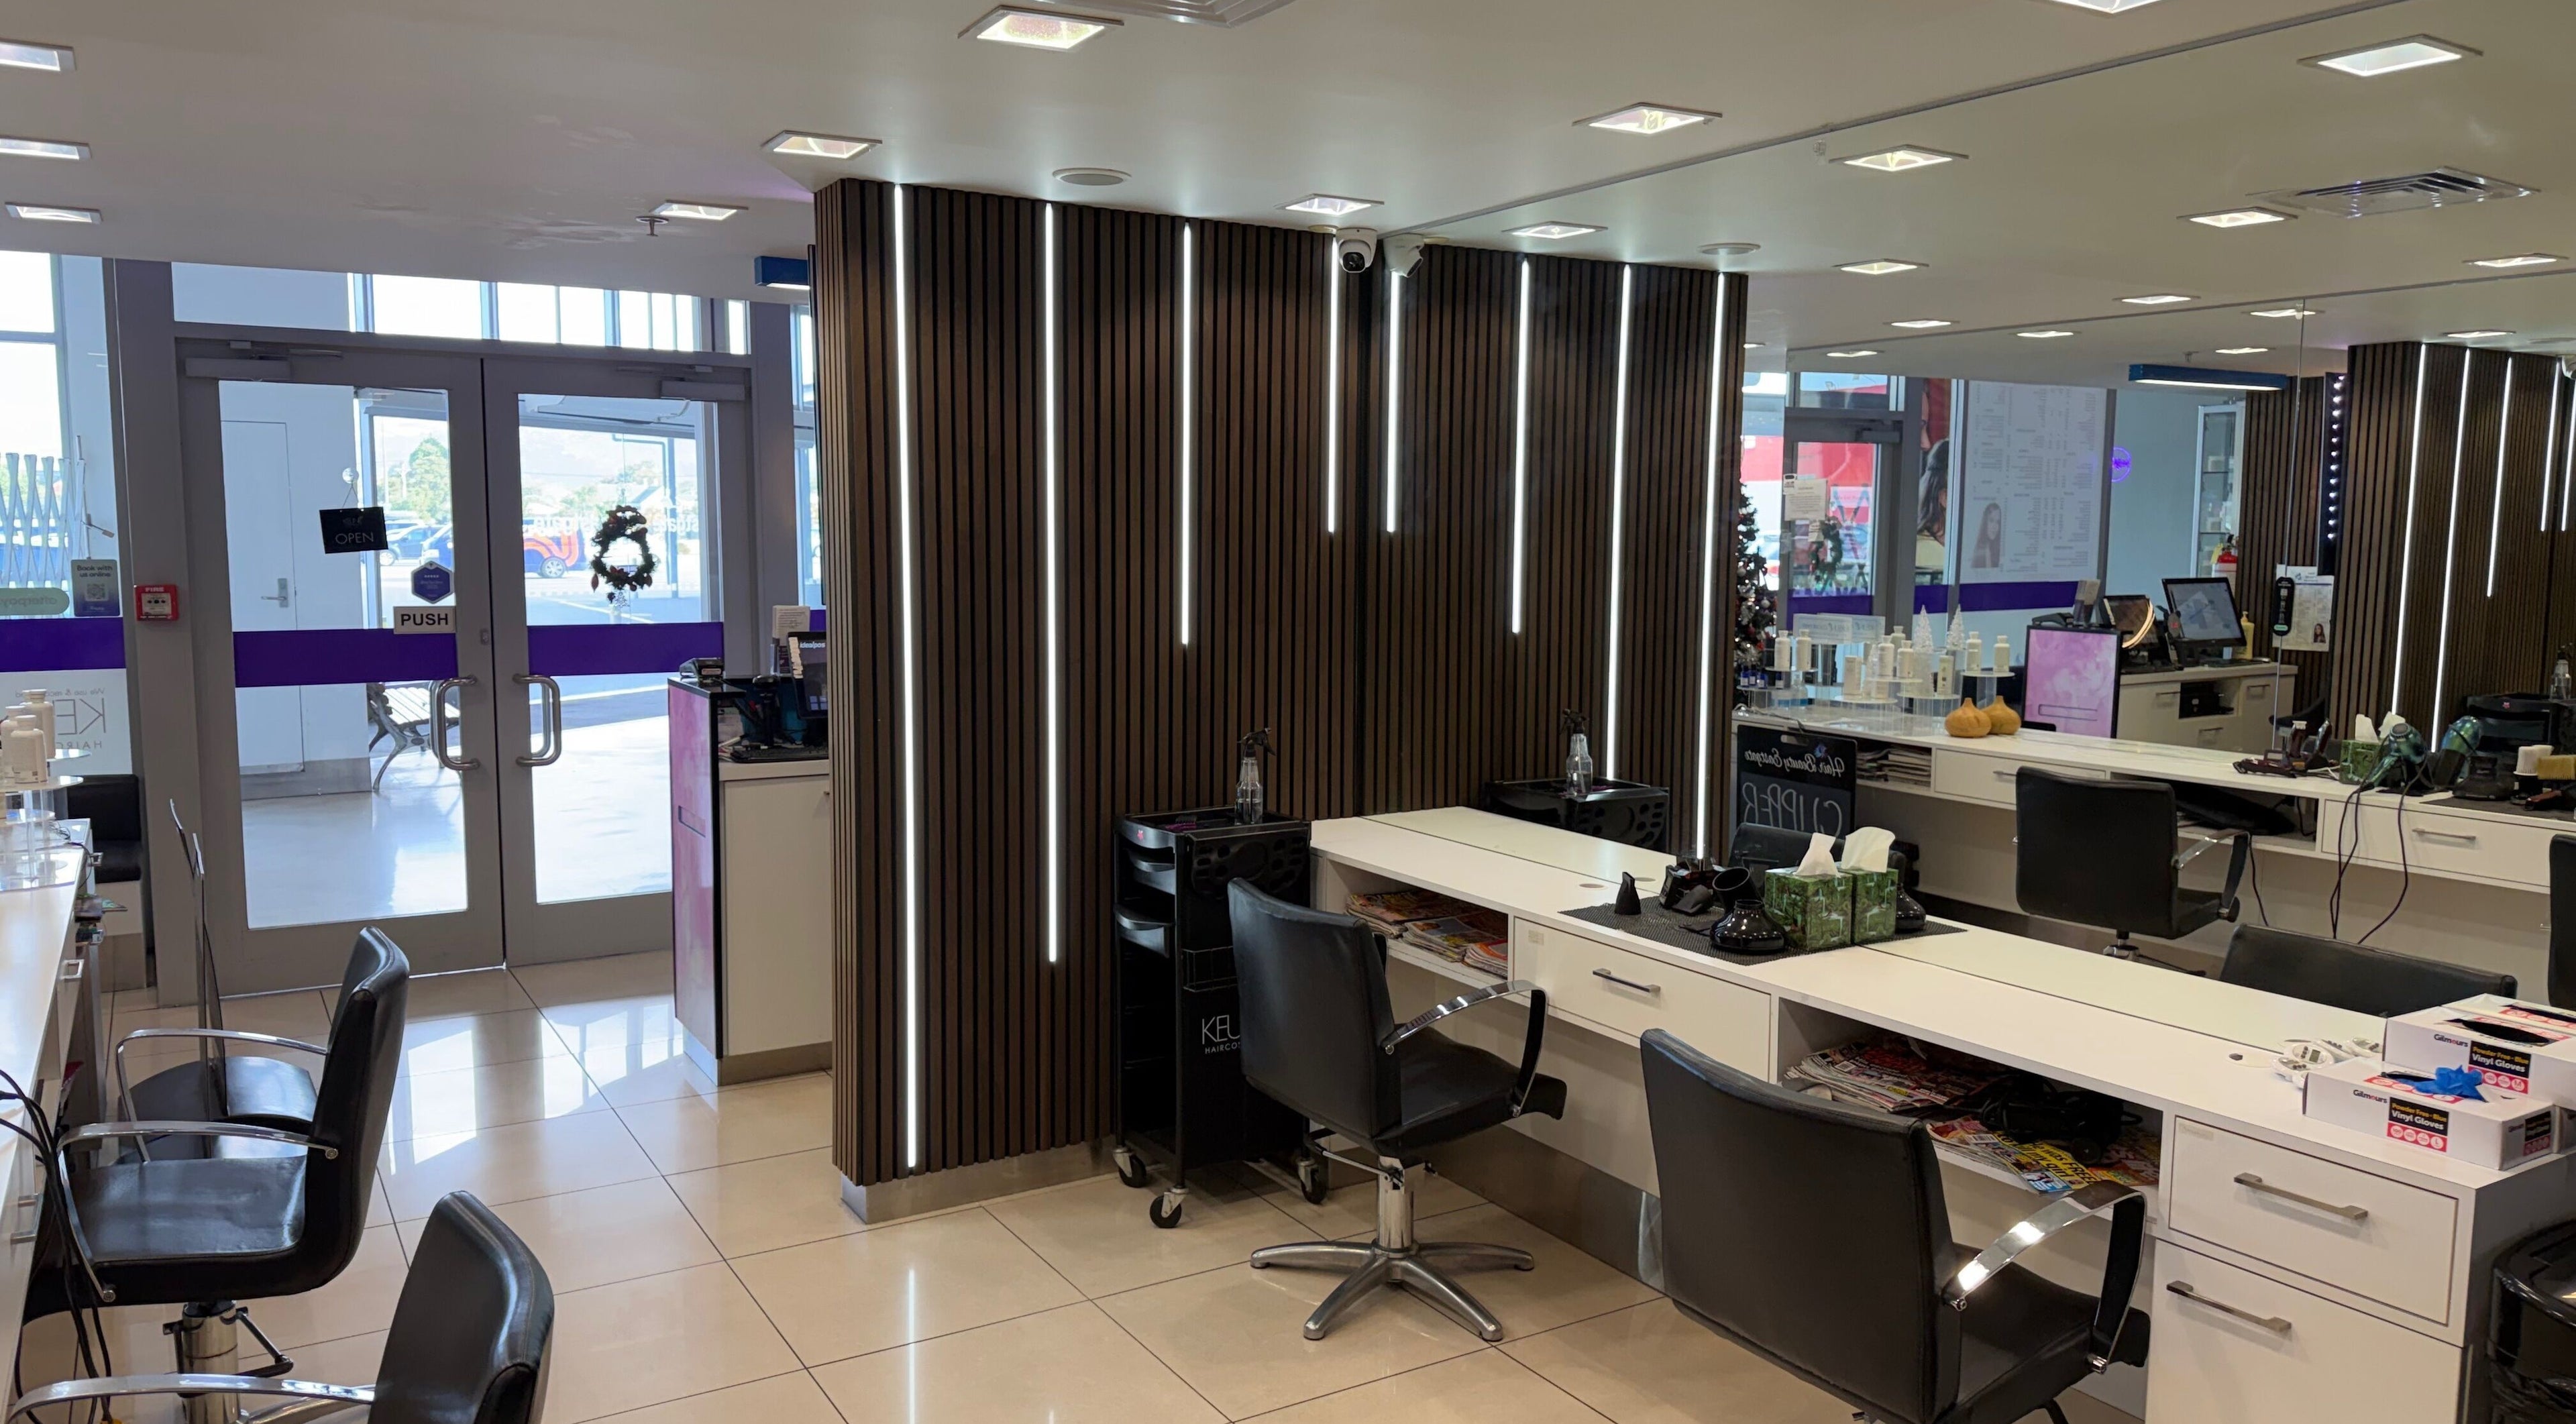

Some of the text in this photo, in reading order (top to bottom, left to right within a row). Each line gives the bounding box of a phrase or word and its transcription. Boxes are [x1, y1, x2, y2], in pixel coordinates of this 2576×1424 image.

[335, 532, 374, 545] OPEN
[400, 613, 449, 626] PUSH
[800, 641, 826, 649] idealpos
[2434, 1034, 2468, 1048] Gilmours
[2472, 1046, 2496, 1057] Powder
[2497, 1052, 2510, 1060] Free
[2472, 1053, 2525, 1073] Vinyl Gloves
[2353, 1089, 2387, 1104] Gilmours
[2392, 1103, 2415, 1114] Powder
[2416, 1108, 2430, 1117] Free
[2392, 1110, 2444, 1130] Vinyl Gloves
[2043, 1148, 2069, 1162] was
[2027, 1151, 2051, 1162] my
[2045, 1162, 2075, 1178] girl
